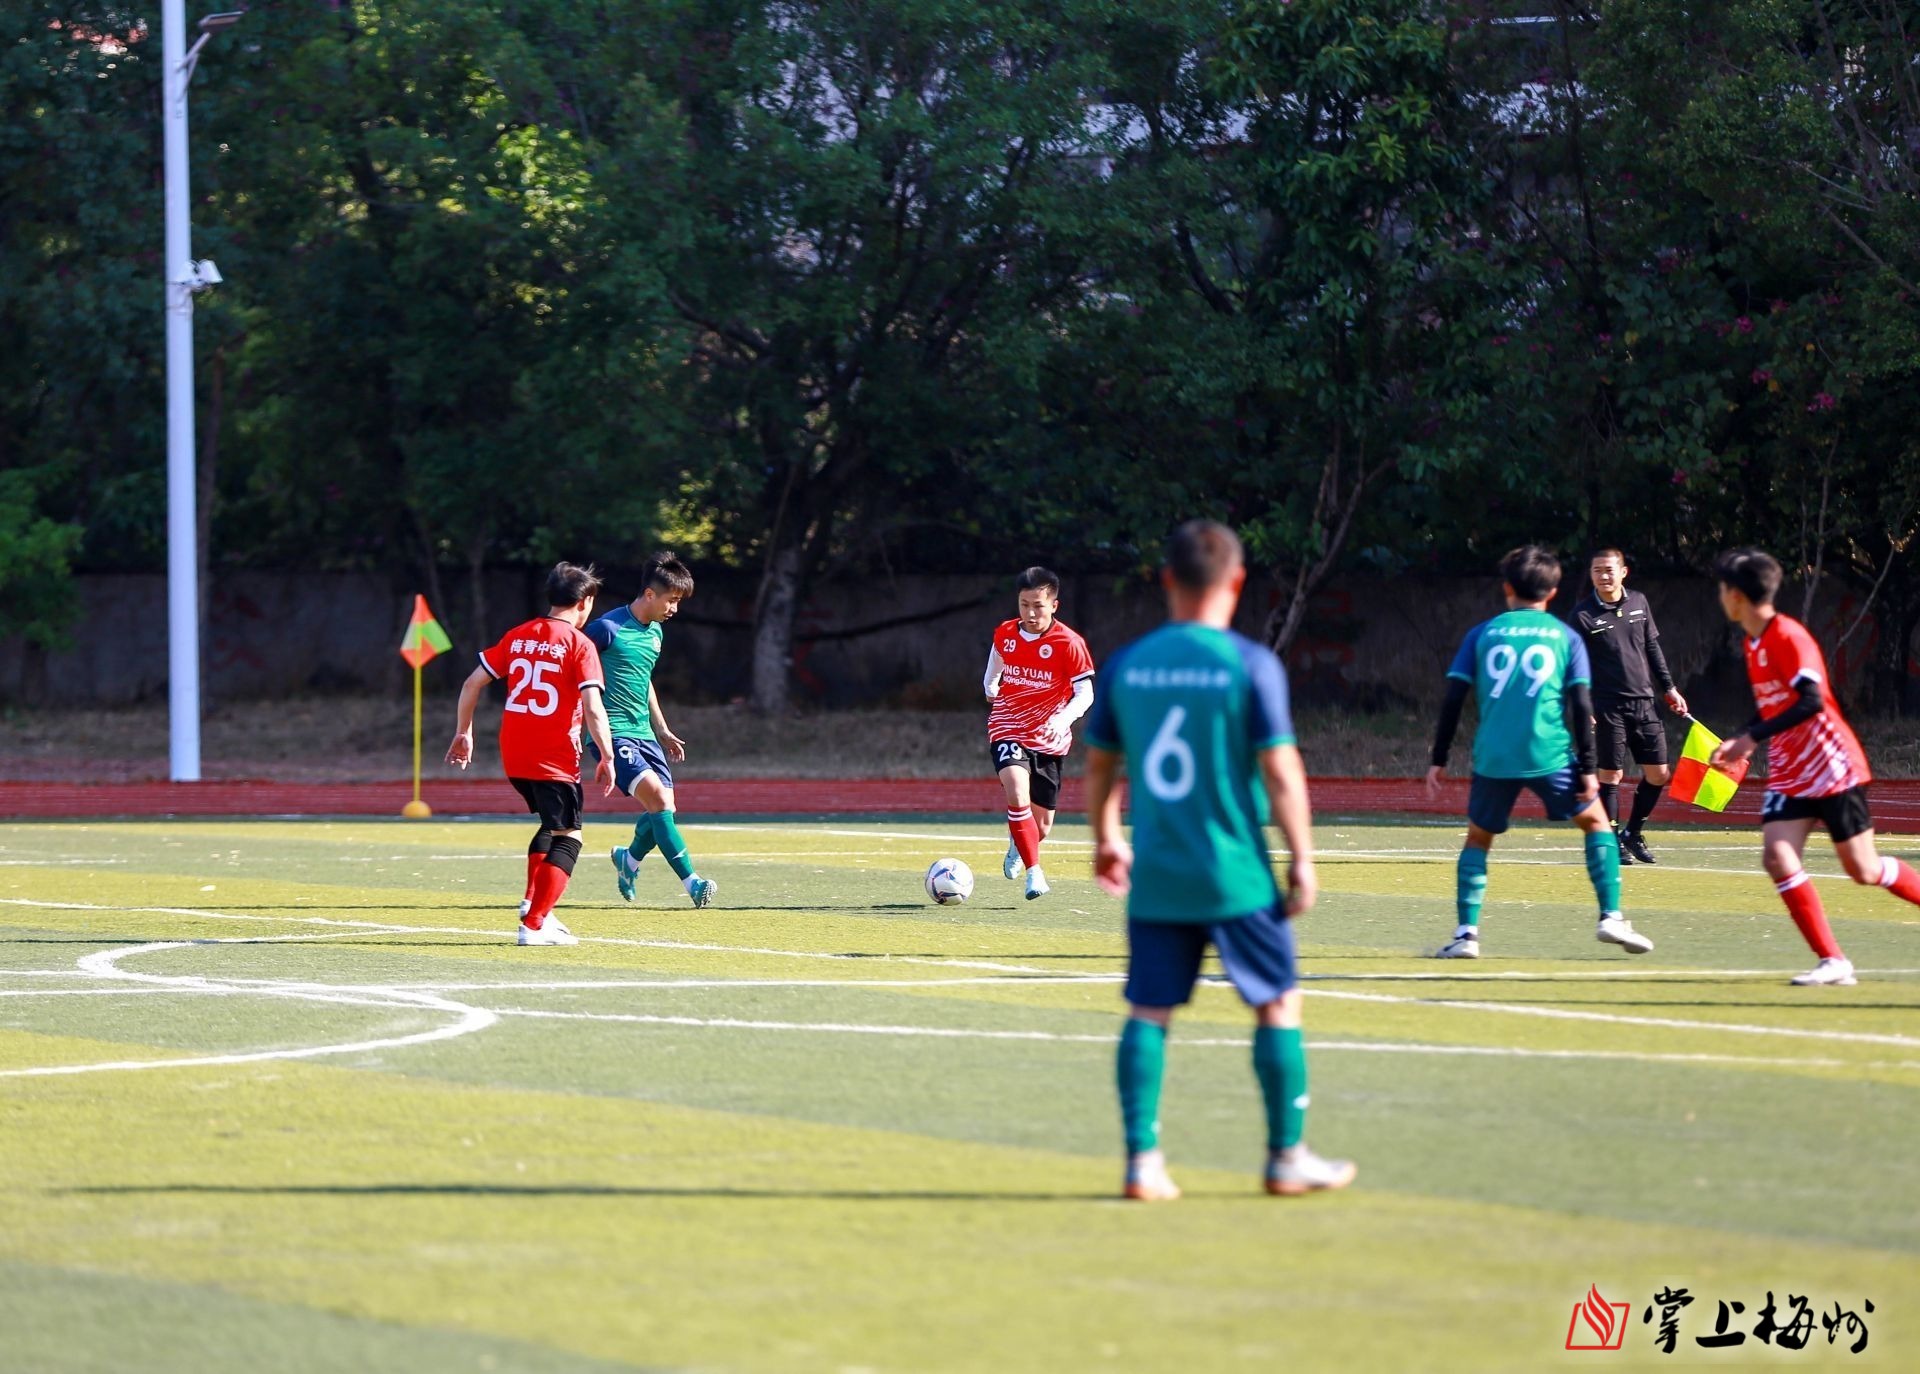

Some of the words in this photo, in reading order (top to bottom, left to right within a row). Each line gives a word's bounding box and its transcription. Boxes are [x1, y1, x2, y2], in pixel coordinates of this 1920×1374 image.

[510, 639, 567, 659] 梅青中学
[1003, 639, 1016, 652] 29
[1022, 667, 1053, 681] YUAN
[1486, 644, 1556, 699] 99
[505, 658, 559, 717] 25
[618, 745, 634, 765] 9
[997, 742, 1023, 762] 29
[1144, 705, 1195, 801] 6
